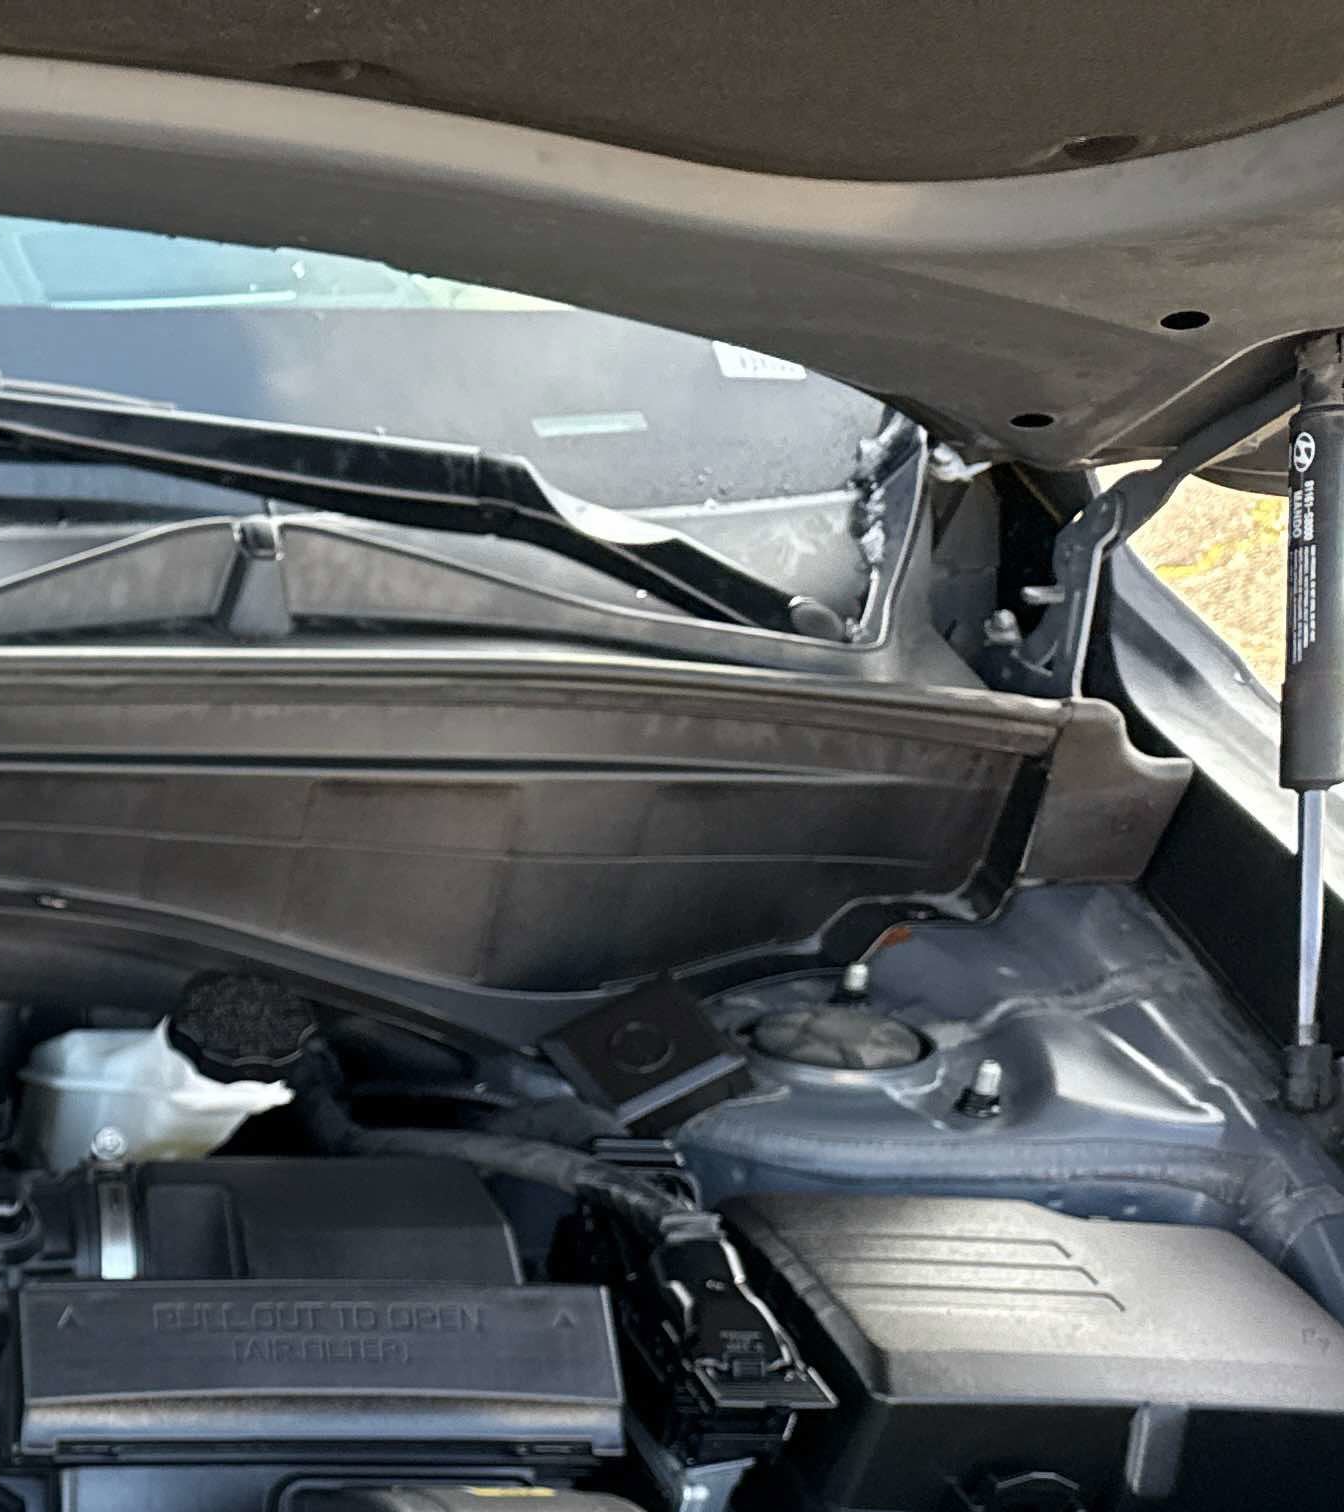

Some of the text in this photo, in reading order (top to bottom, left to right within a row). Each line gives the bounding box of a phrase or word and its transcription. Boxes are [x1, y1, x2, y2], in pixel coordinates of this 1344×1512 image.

[152, 1301, 485, 1331] PULL OUT TO OPEN
